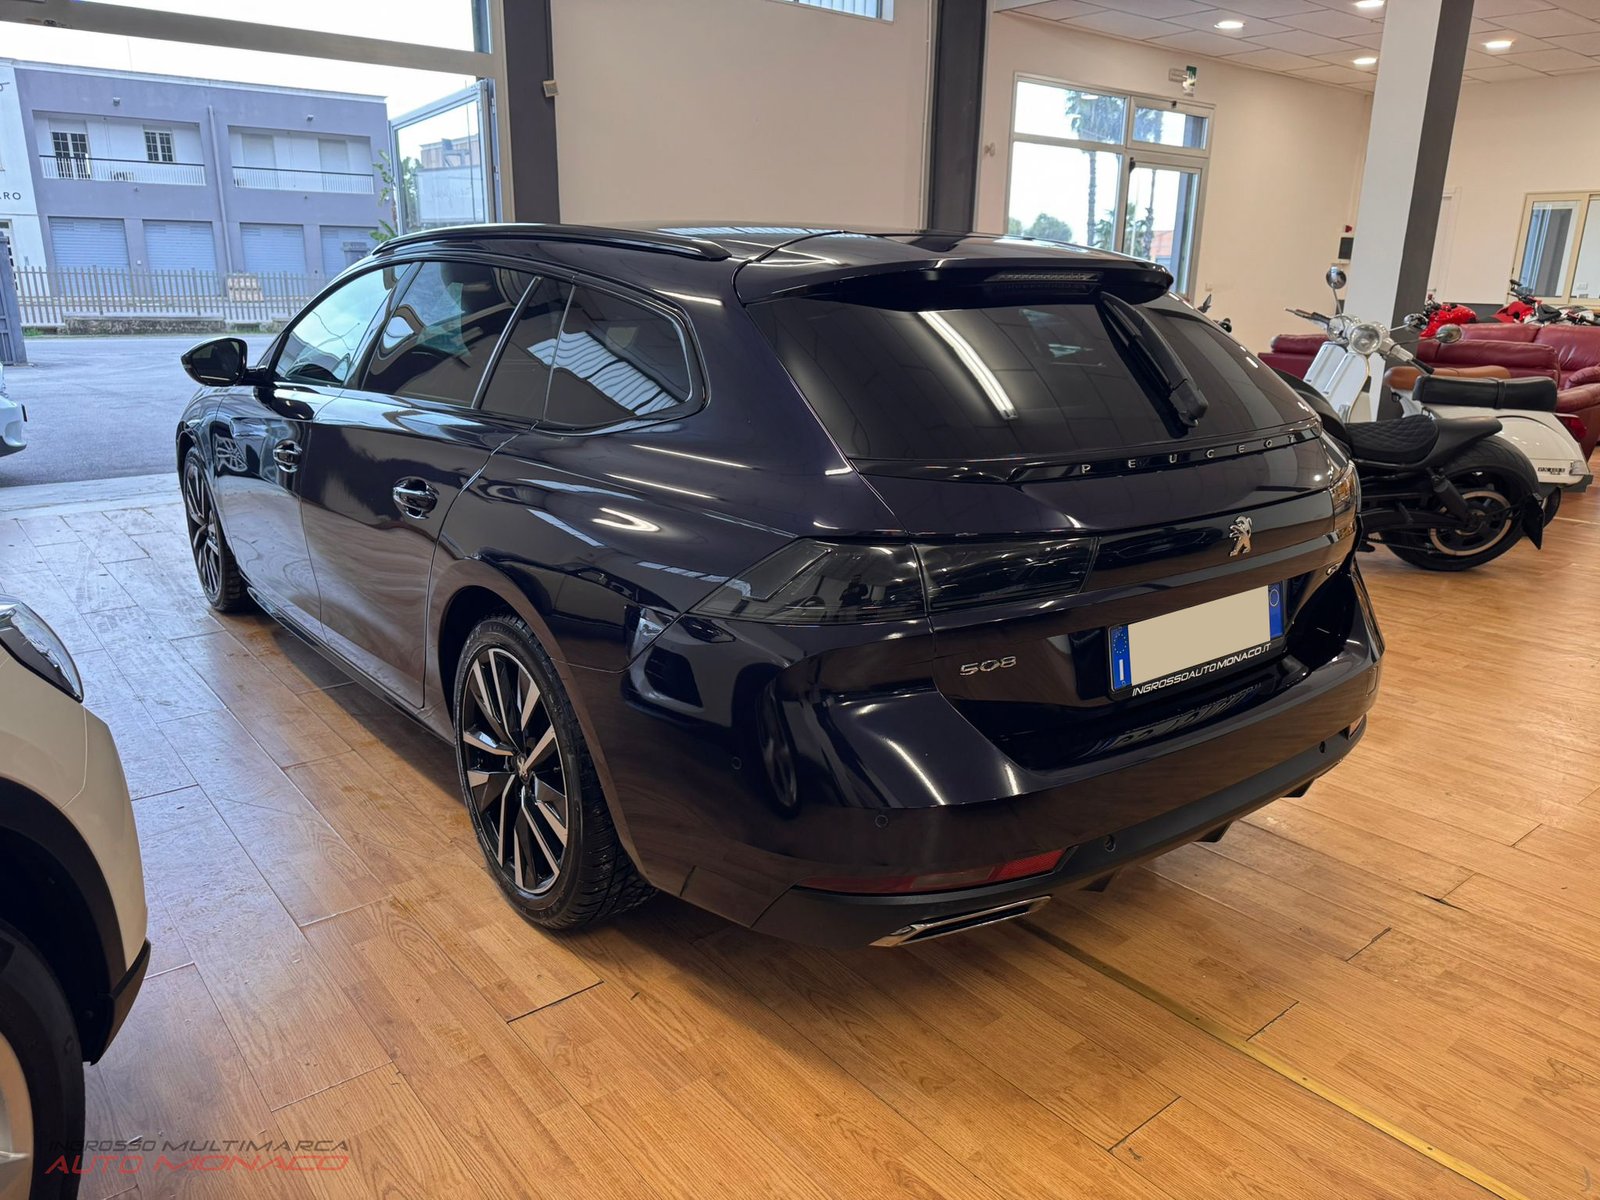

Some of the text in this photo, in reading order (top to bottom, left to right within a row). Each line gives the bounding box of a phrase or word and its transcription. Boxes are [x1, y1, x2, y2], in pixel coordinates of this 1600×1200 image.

[0, 191, 22, 201] RO
[1081, 434, 1296, 475] PEUGEOT
[959, 655, 1017, 676] 508
